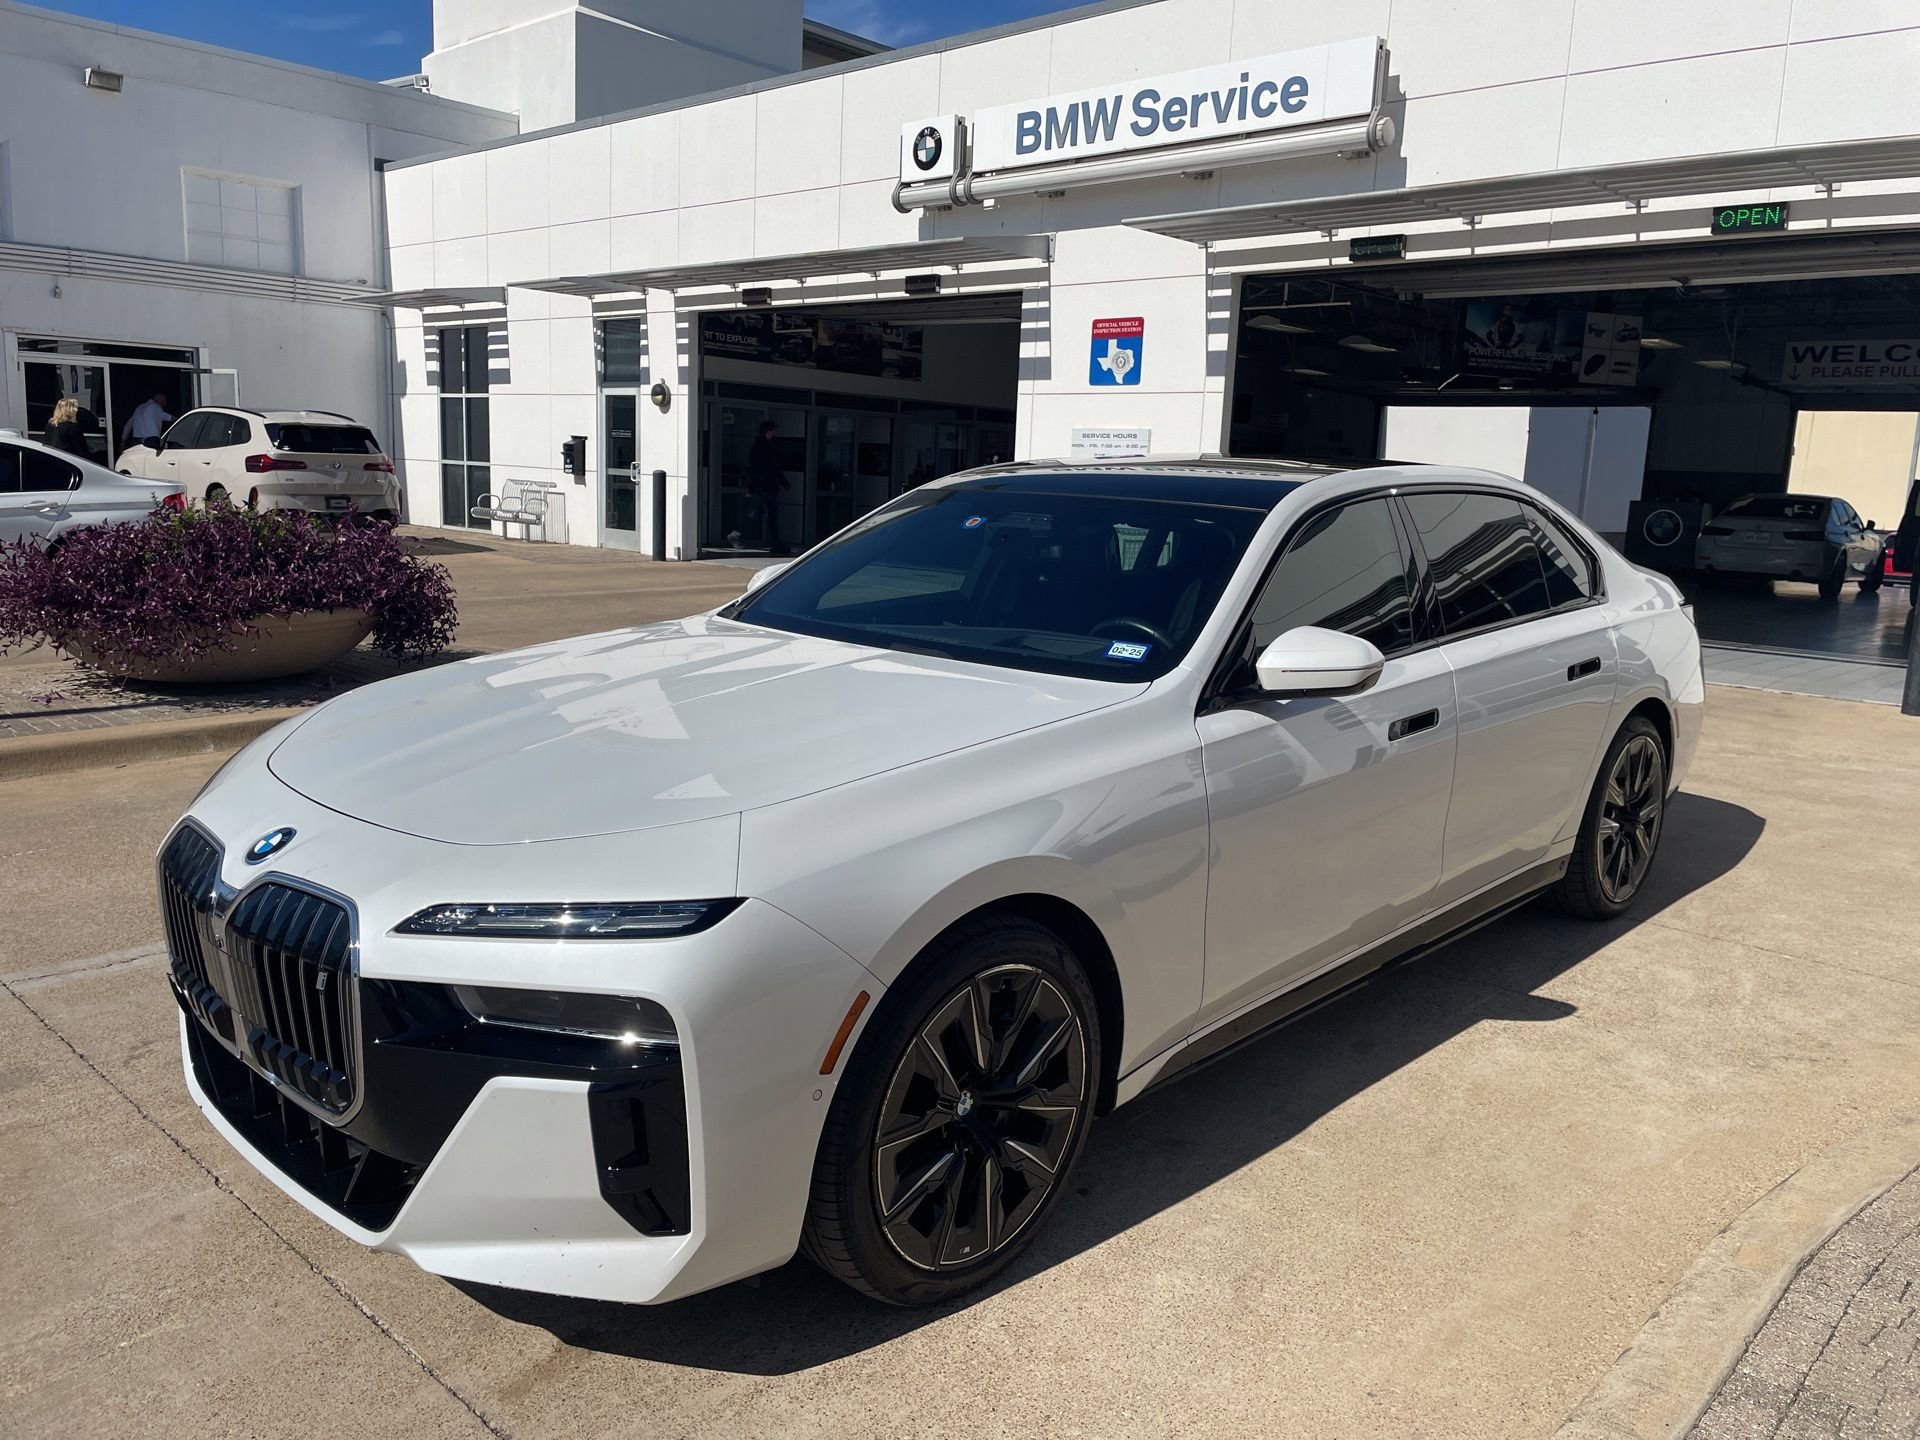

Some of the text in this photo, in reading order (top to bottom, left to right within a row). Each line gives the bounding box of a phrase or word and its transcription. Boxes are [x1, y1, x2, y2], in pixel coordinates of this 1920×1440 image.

[1016, 72, 1309, 155] BMW Service
[1719, 206, 1780, 228] OPEN
[715, 332, 726, 341] TO
[727, 334, 759, 345] EXPLORE
[1791, 344, 1920, 363] WELC
[1810, 366, 1920, 378] PLEASE PULL
